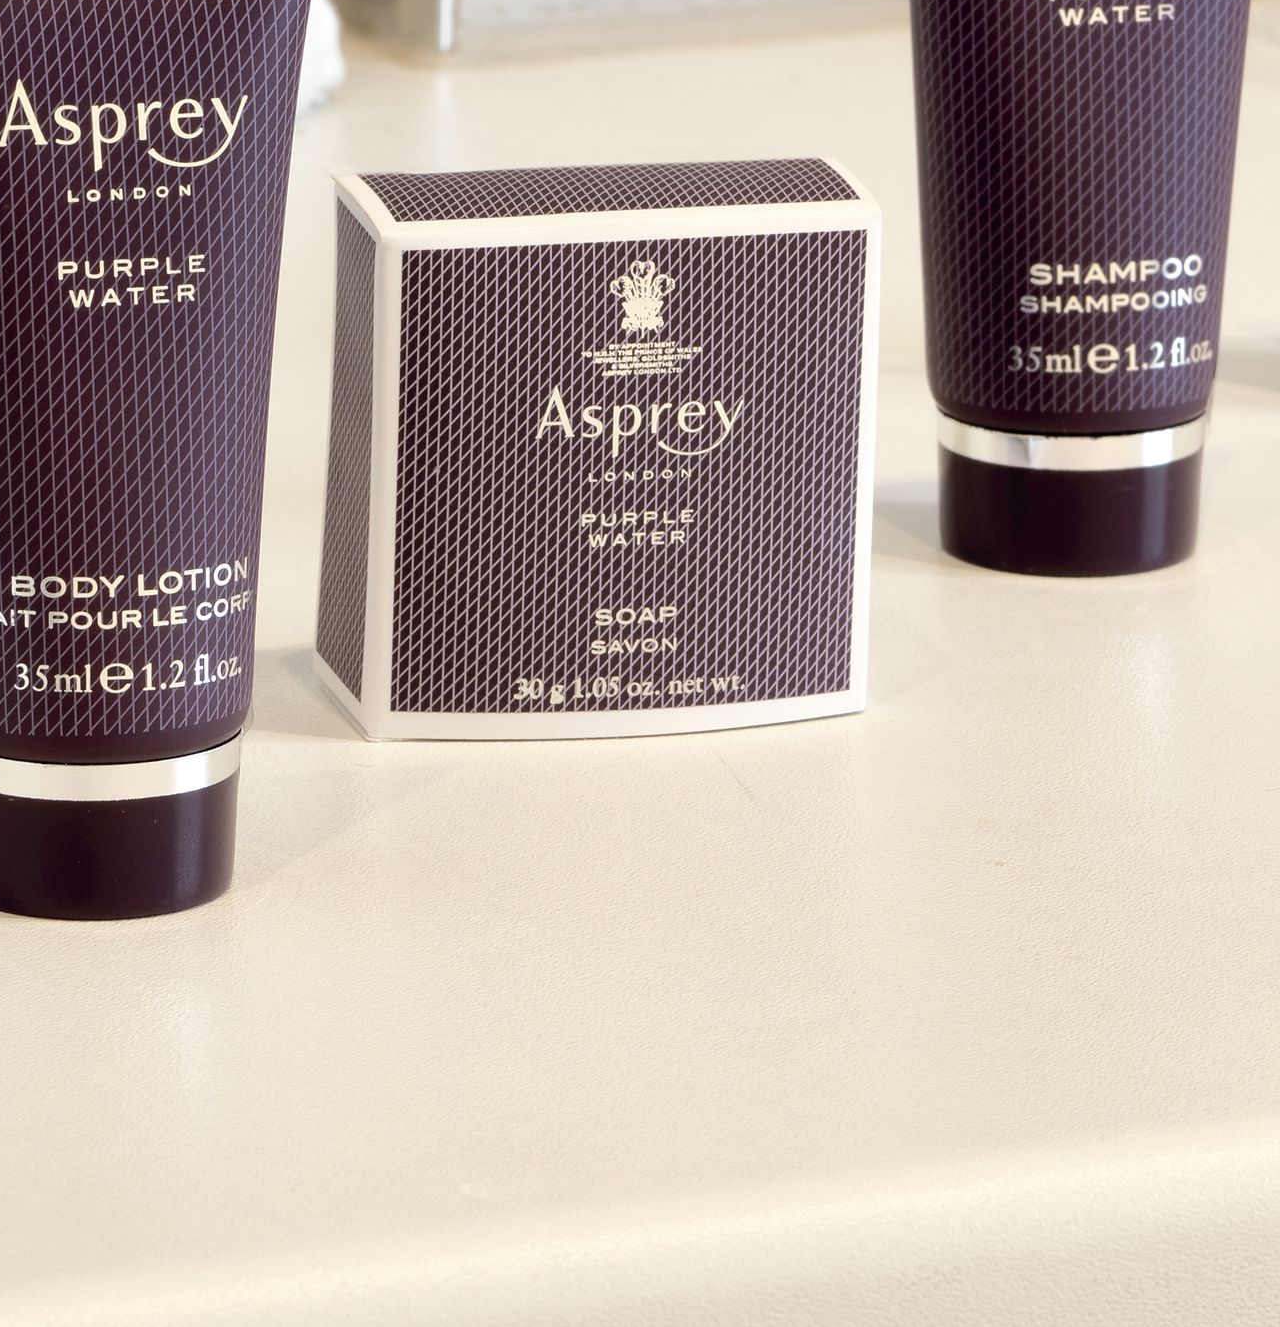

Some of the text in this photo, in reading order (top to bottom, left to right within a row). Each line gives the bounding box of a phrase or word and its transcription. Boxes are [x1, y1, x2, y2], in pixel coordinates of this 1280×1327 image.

[1059, 3, 1175, 27] WATER
[67, 184, 192, 203] LONDON
[58, 254, 206, 281] PURPLE
[1029, 254, 1203, 286] SHAMPOO
[69, 284, 196, 308] WATER
[1019, 284, 1207, 314] SHAMPOOING
[535, 385, 744, 458] Asprey
[588, 468, 692, 483] LONDON
[581, 509, 695, 527] PURPLE
[589, 530, 686, 548] WATER
[11, 556, 248, 598] BODY LOTION
[48, 609, 142, 630] POUR
[153, 605, 188, 627] LE
[196, 588, 254, 621] CORP
[595, 606, 677, 625] SOAP
[591, 637, 677, 655] SAVON
[513, 674, 746, 705] 30 g 1.05 oz. net wt.
